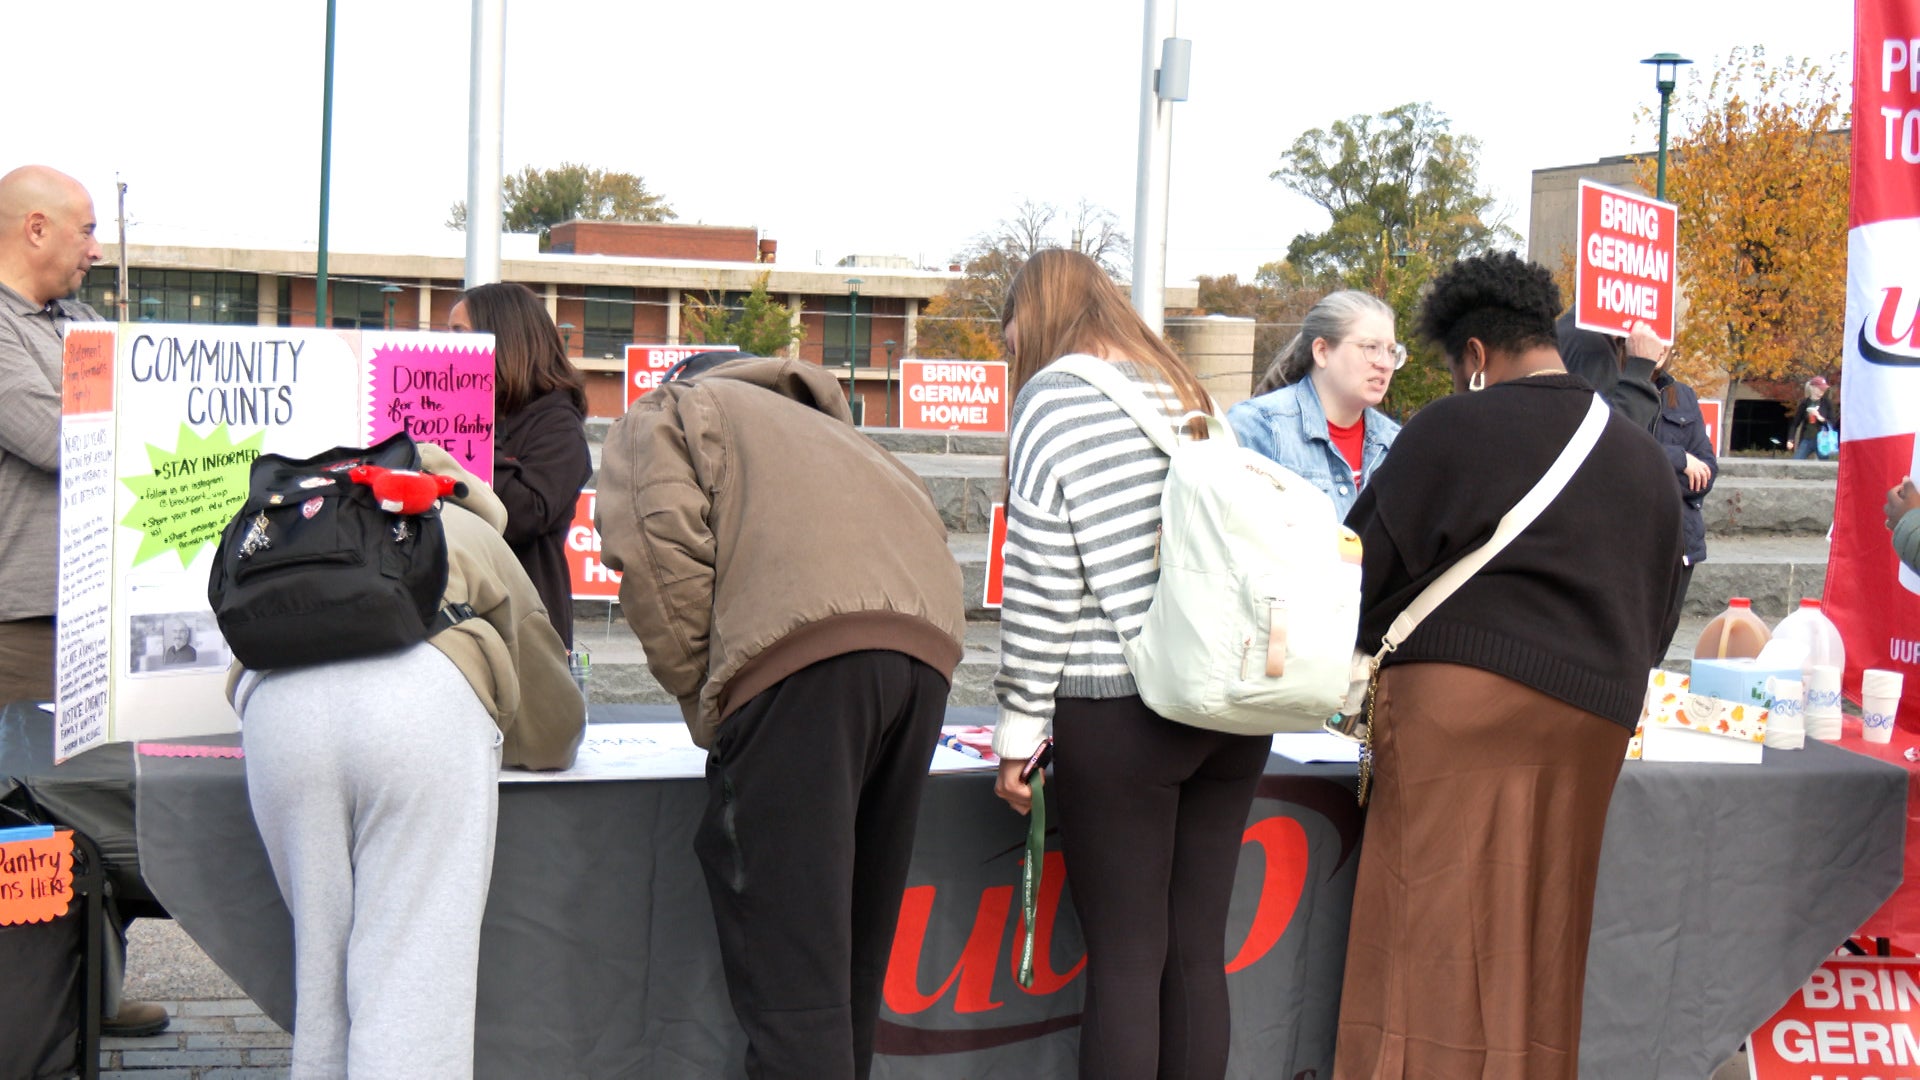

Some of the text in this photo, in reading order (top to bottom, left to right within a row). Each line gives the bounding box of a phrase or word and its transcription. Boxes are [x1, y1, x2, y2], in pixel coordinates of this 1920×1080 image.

[1880, 106, 1920, 165] TO
[1600, 194, 1659, 241] BRING
[1587, 232, 1669, 282] GERMÁN
[1597, 275, 1658, 320] HOME!
[131, 334, 305, 384] COMMUNITY
[648, 350, 701, 368] BRI
[922, 364, 986, 383] BRING
[393, 363, 493, 394] Donations
[634, 370, 670, 388] GE
[909, 382, 999, 405] GERMÁN
[187, 385, 293, 426] COUNTS
[388, 396, 445, 423] for the
[920, 405, 988, 424] HOME!
[404, 413, 493, 441] FOOD Pantry
[162, 449, 260, 480] STAY INFORMED
